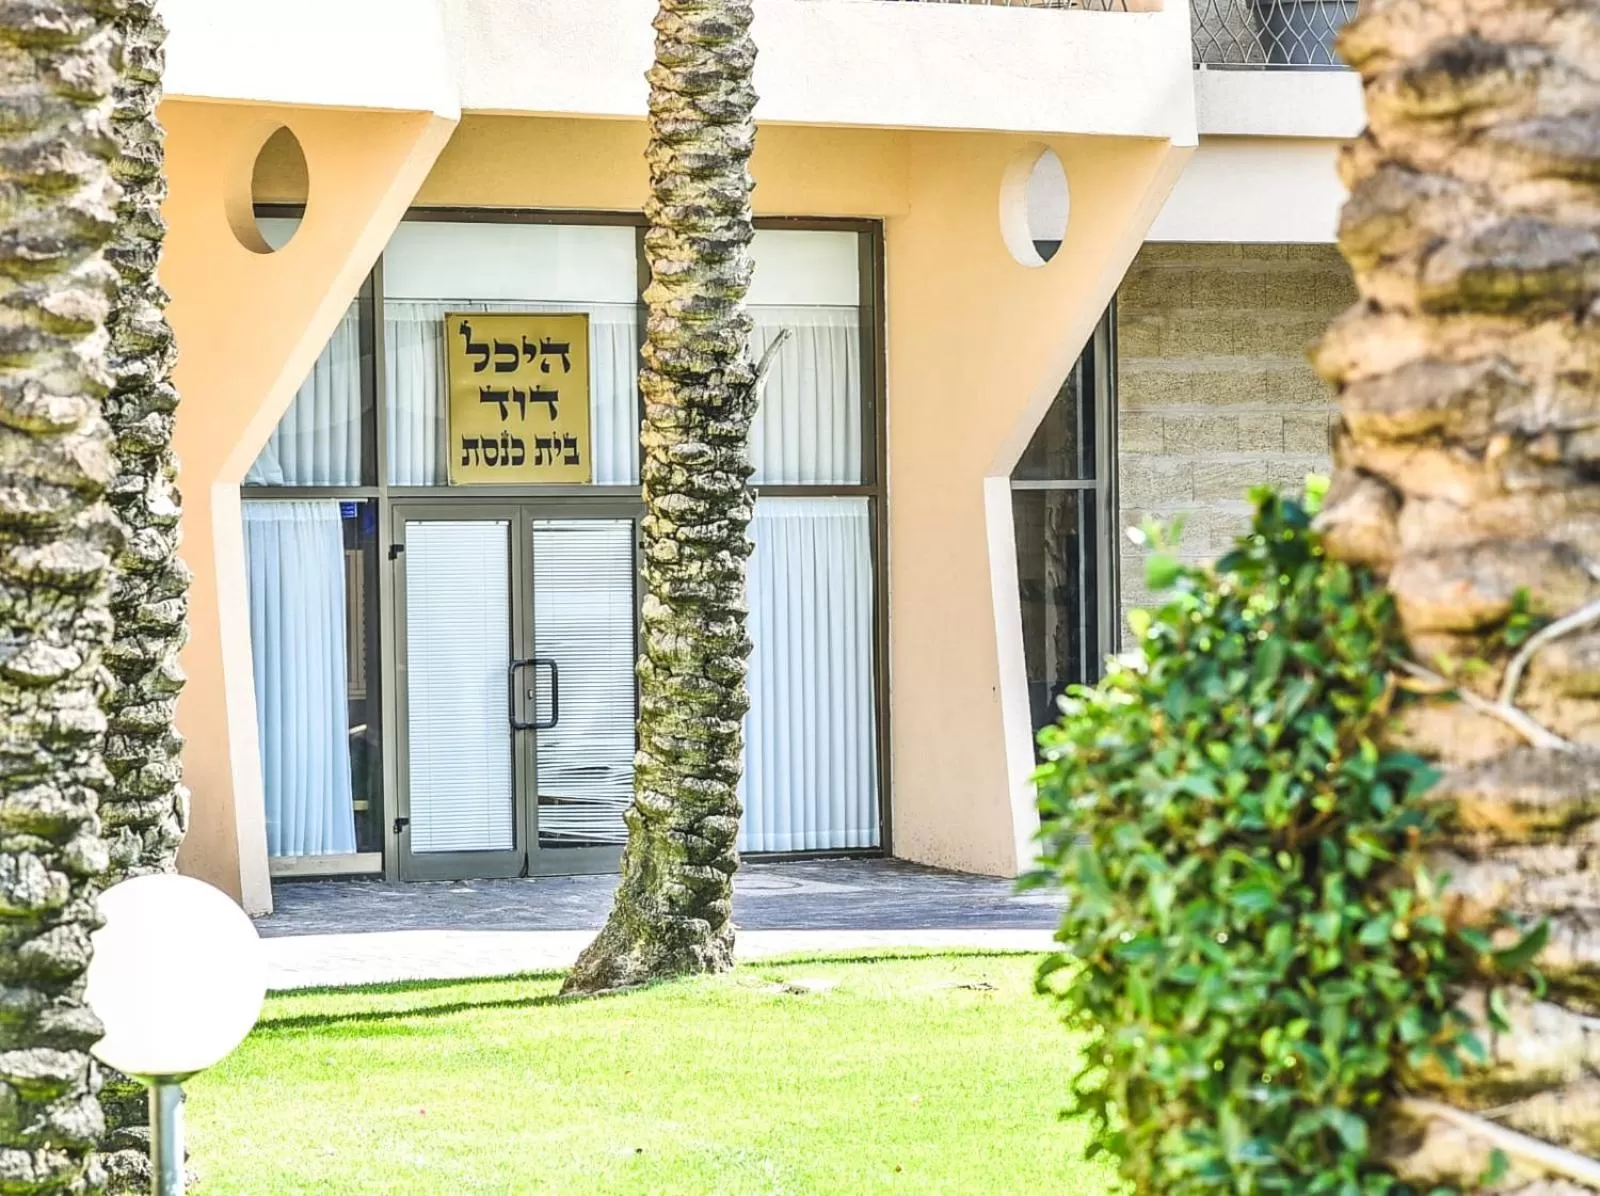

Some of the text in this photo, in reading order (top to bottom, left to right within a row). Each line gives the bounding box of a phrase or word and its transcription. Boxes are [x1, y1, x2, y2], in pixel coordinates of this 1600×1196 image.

[459, 319, 571, 374] היכל
[479, 385, 559, 421] דוד
[461, 430, 580, 467] בית כנסת
